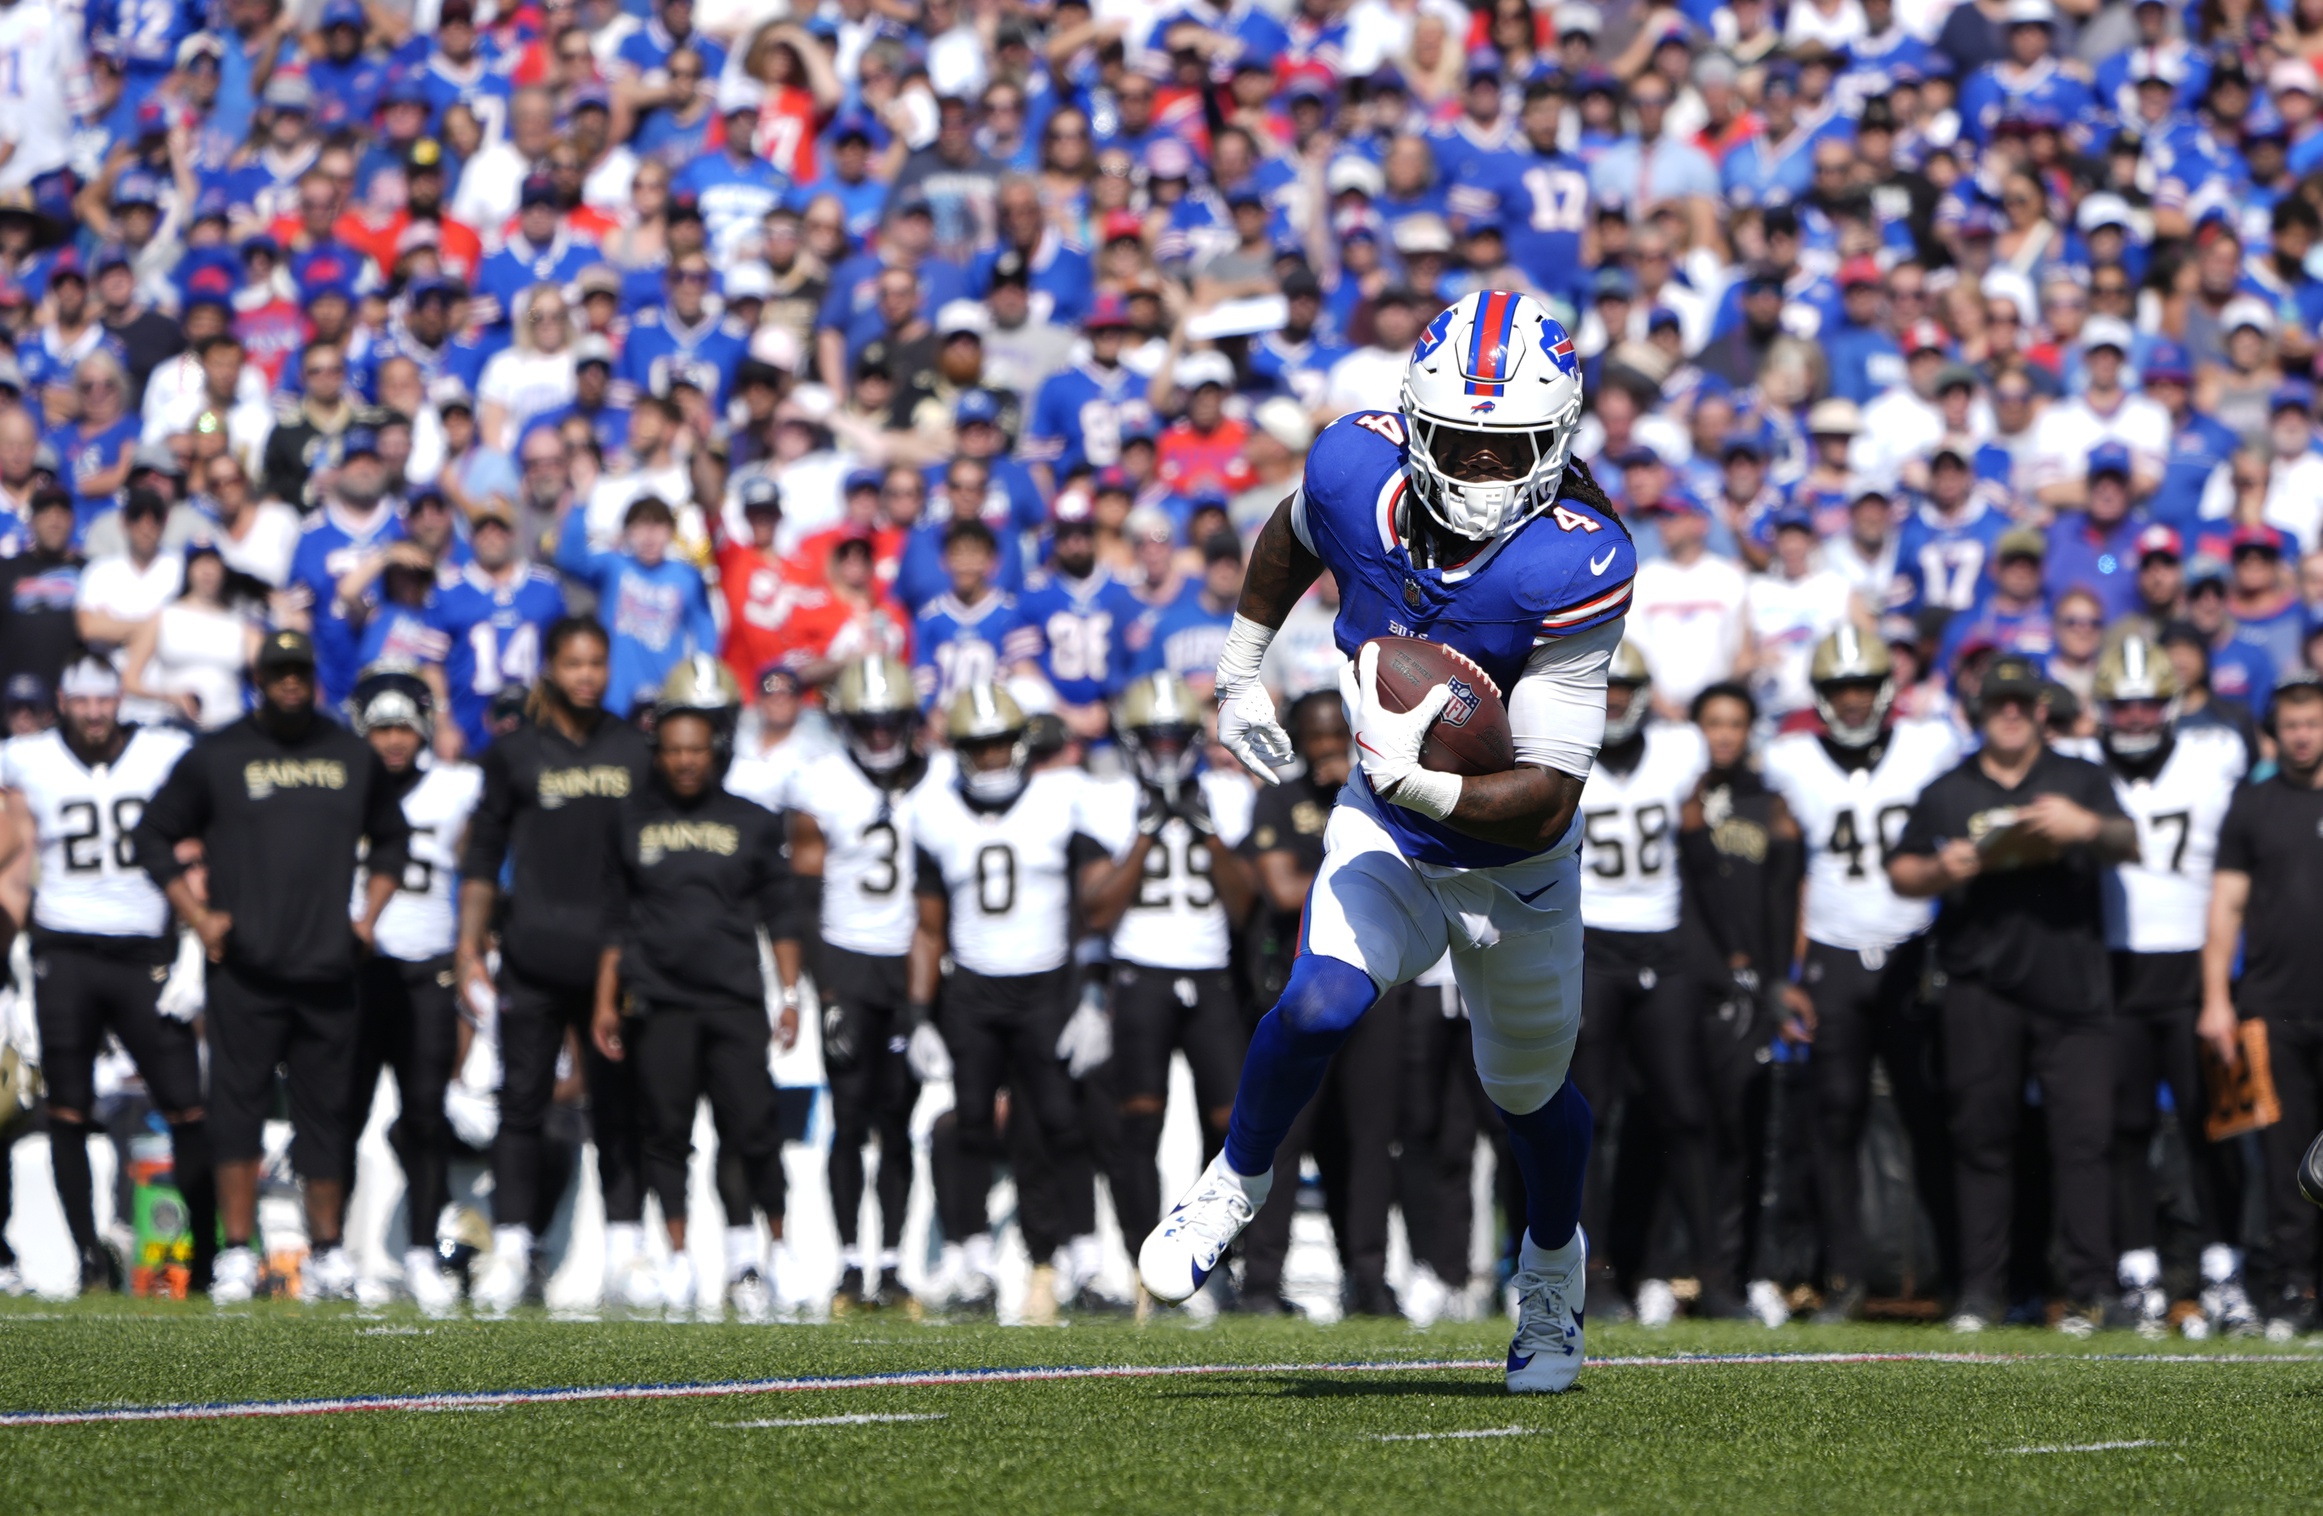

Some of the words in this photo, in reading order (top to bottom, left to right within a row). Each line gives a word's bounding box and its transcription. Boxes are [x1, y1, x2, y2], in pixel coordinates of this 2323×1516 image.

[1522, 167, 1587, 232] 17
[1352, 413, 1409, 447] 4
[1552, 505, 1604, 535] 4
[1917, 539, 1984, 611] 17
[469, 619, 541, 696] 14
[244, 758, 348, 790] SAINTS
[861, 819, 898, 896] 3
[1583, 803, 1669, 878] 58
[2149, 808, 2191, 874] 7
[977, 843, 1014, 915] 0
